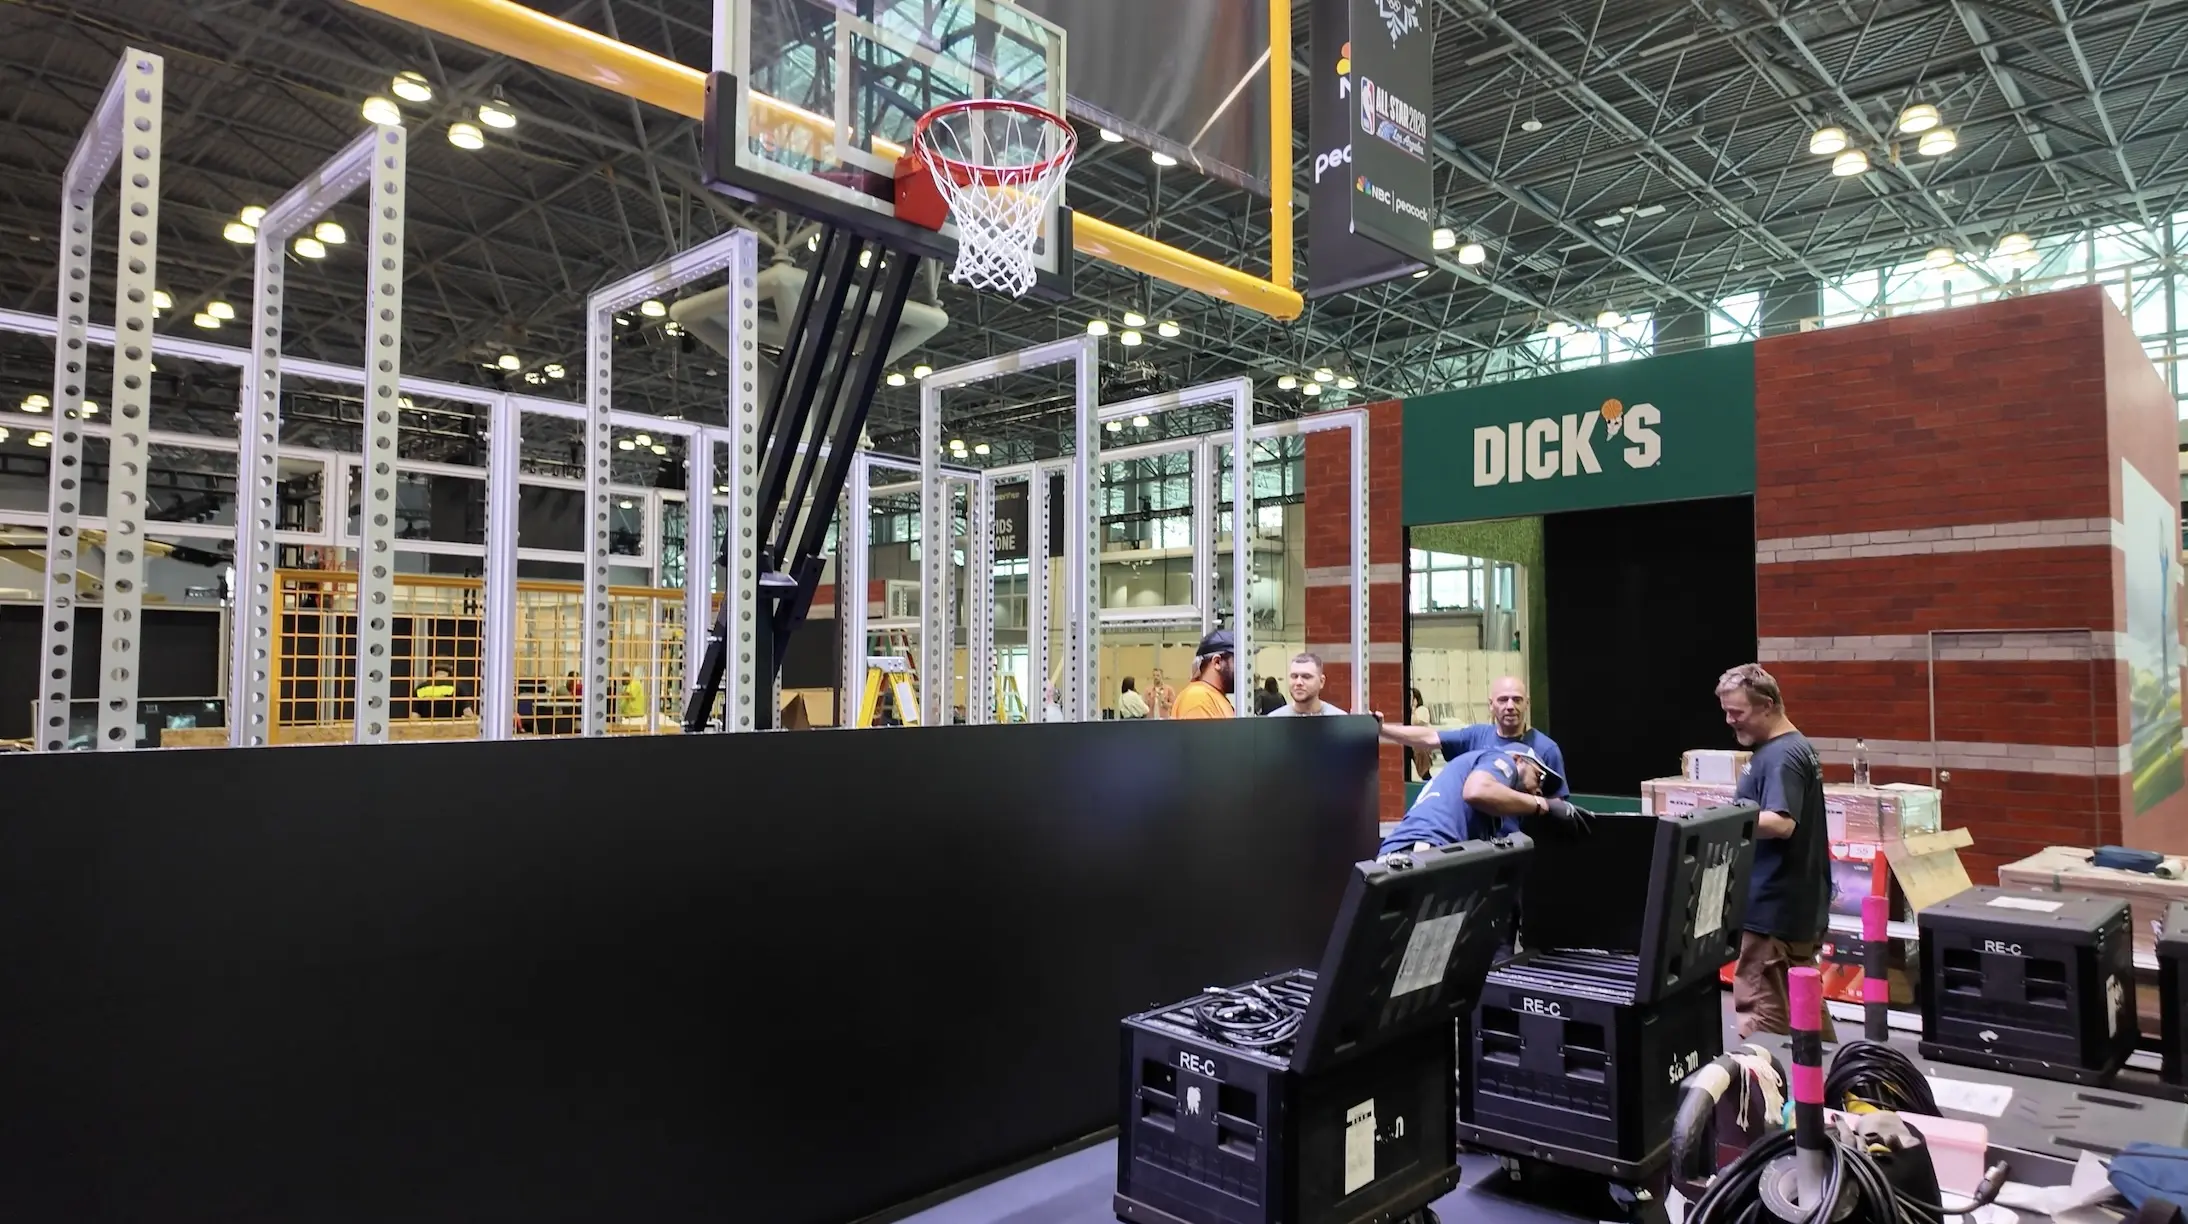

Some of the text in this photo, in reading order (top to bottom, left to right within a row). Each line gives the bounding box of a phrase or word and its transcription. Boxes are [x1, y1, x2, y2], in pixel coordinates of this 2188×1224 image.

[1376, 86, 1427, 139] ALL STAR 2026
[1371, 184, 1429, 223] NBC peacock
[1473, 399, 1662, 487] DICK'S
[995, 518, 1013, 534] IDS
[995, 534, 1016, 551] ONE
[1984, 939, 2022, 956] RE-C
[1523, 997, 1561, 1017] RE-C
[1179, 1051, 1215, 1077] RE-C
